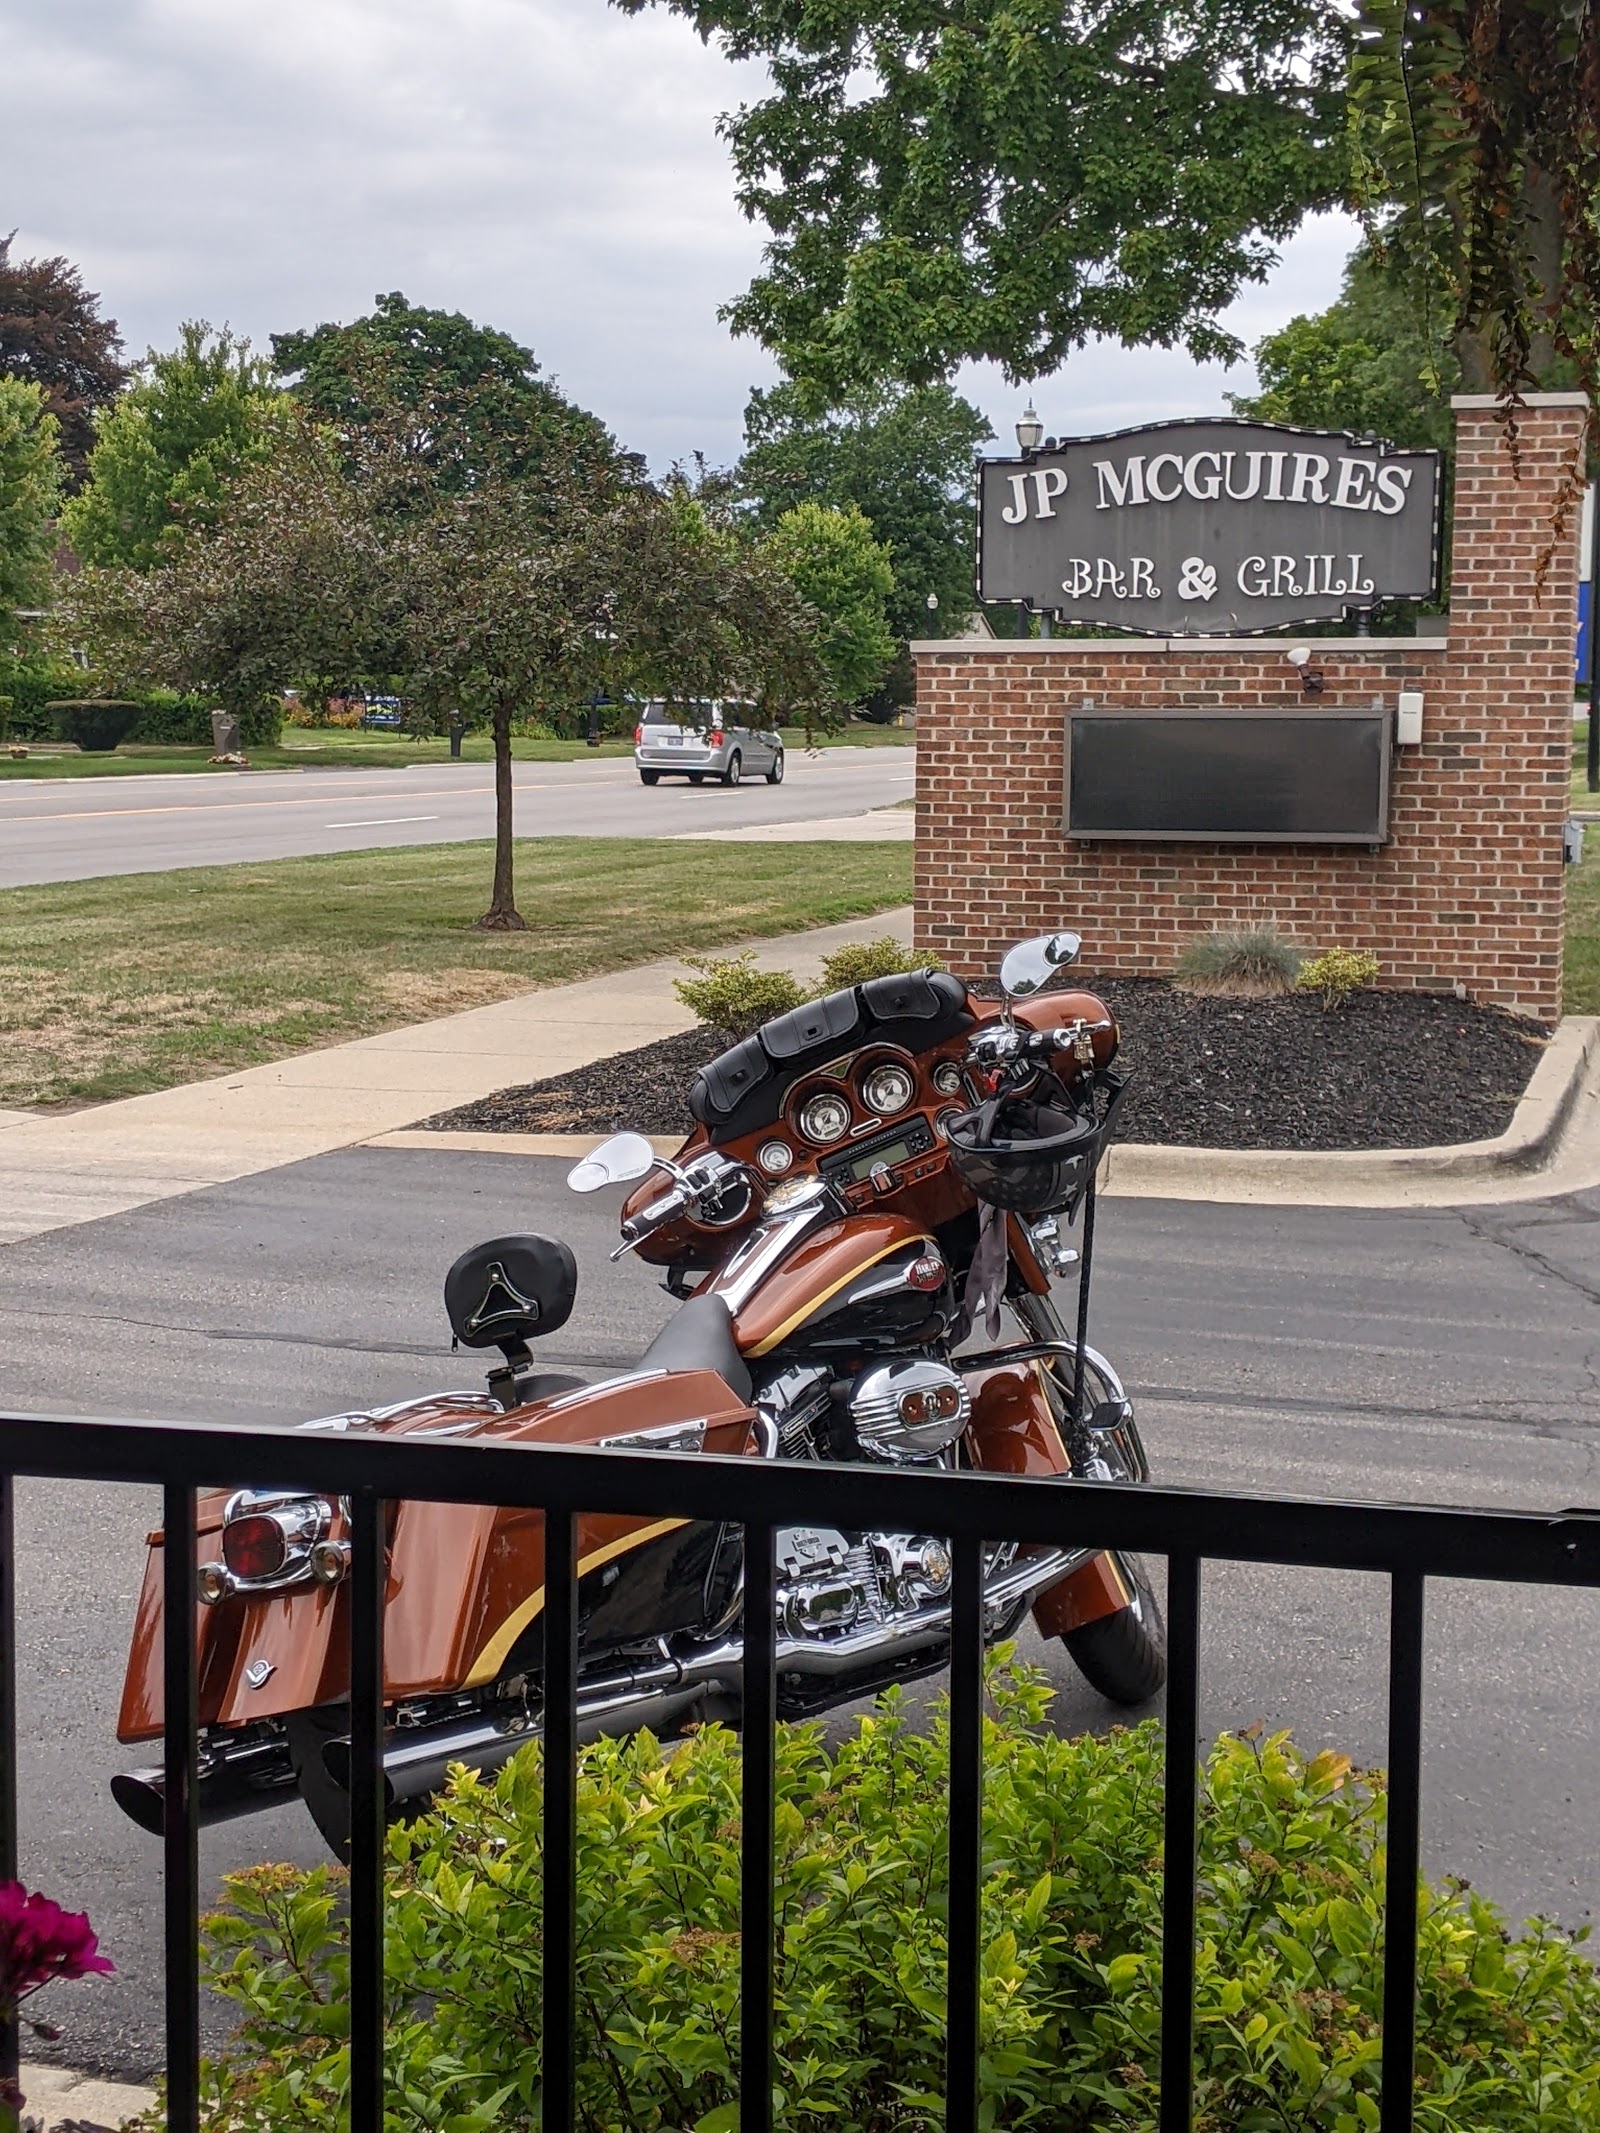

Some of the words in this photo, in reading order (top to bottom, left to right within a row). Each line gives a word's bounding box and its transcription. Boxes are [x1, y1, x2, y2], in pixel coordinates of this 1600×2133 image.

[1001, 468, 1068, 525] JP
[1092, 450, 1414, 516] MCGUIRES
[1061, 557, 1162, 599] BAR
[1177, 557, 1218, 601] &
[1236, 554, 1375, 598] GRILL
